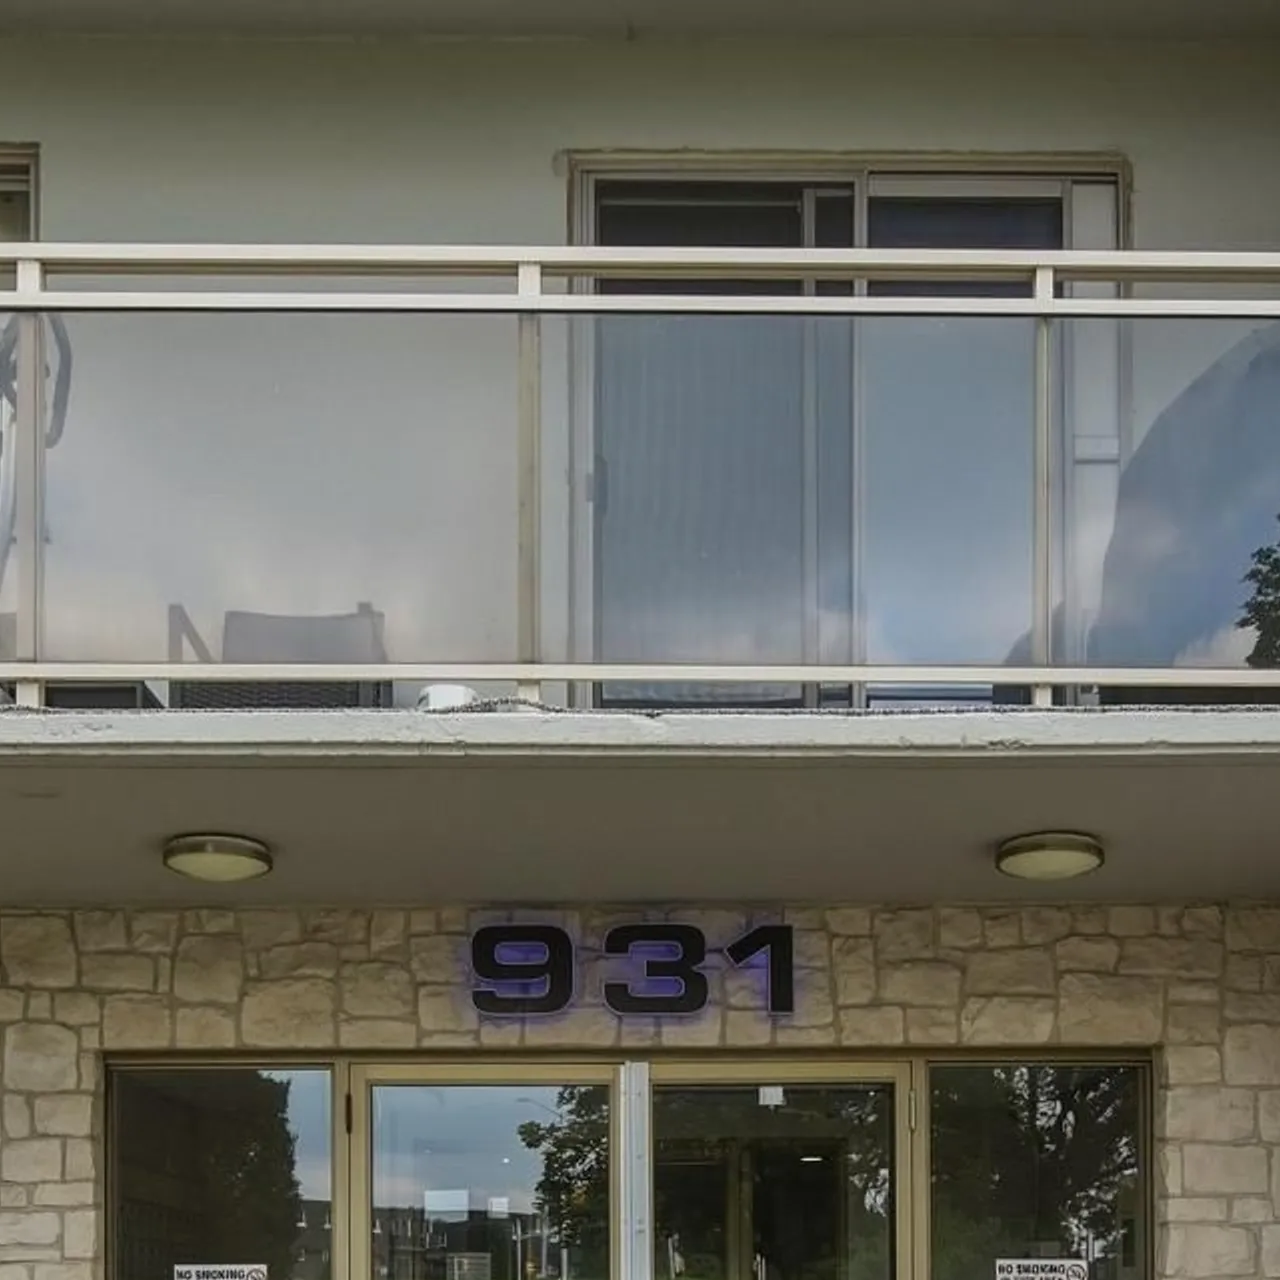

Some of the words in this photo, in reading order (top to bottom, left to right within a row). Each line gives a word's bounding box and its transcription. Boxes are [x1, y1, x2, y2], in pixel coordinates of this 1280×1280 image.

[471, 924, 794, 1015] 931
[176, 1269, 193, 1280] NO
[195, 1269, 246, 1280] SMOKING
[998, 1263, 1013, 1274] NO
[1016, 1263, 1065, 1275] SMOKING
